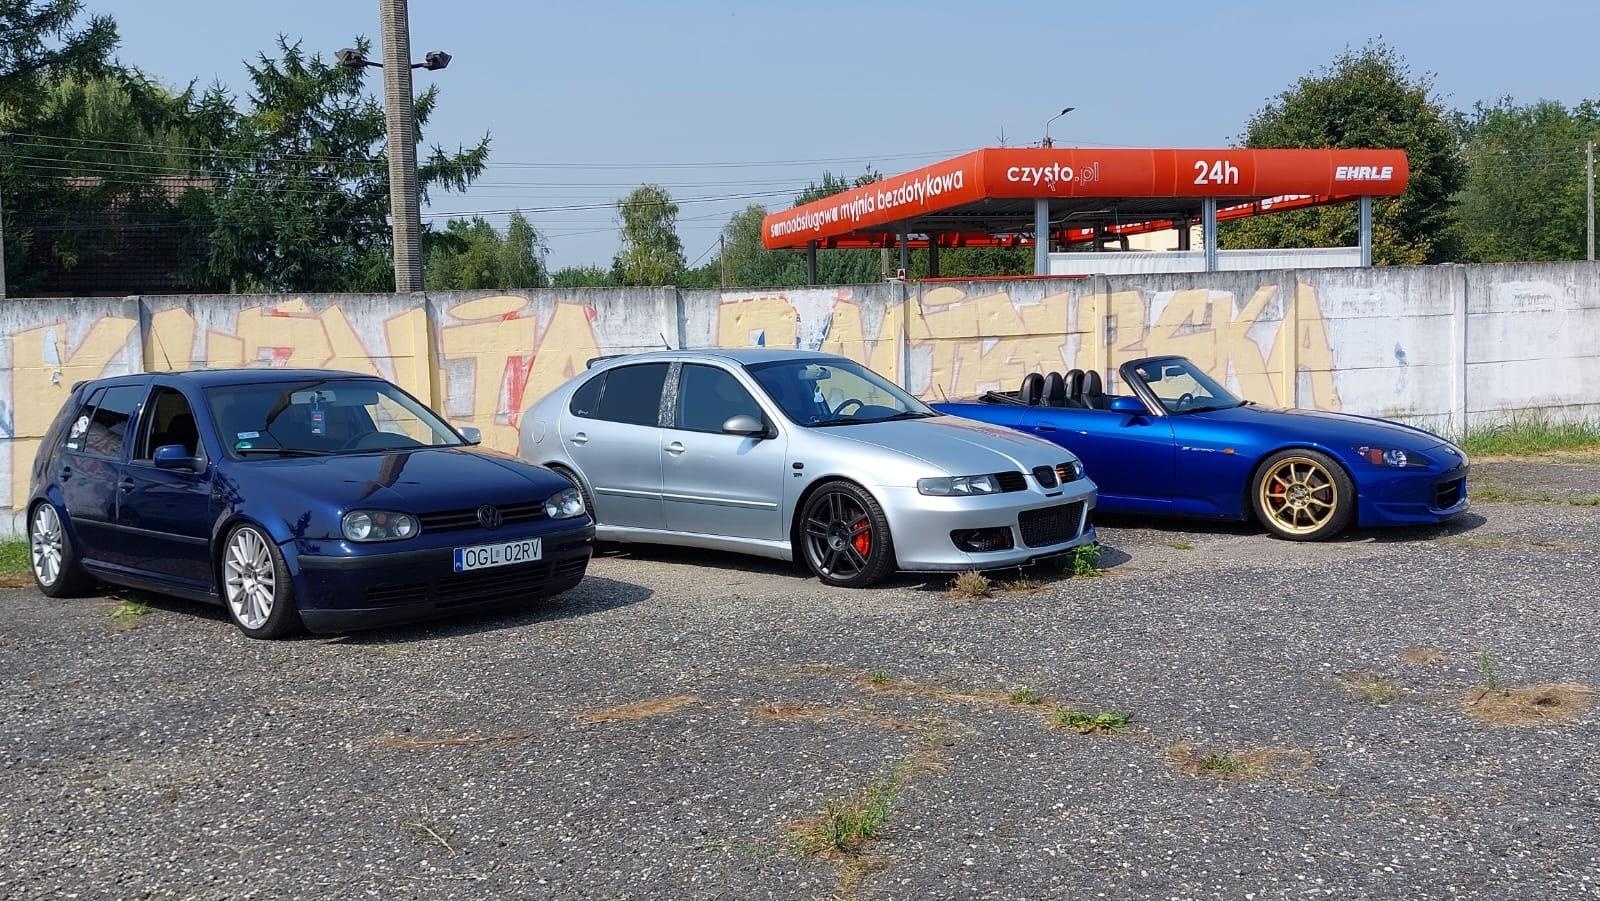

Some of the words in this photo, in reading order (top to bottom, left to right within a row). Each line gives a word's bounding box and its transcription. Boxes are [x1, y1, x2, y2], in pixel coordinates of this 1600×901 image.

[1007, 162, 1100, 187] czysto.pl
[1194, 160, 1239, 185] 24h
[1335, 166, 1393, 181] EHRLE
[840, 192, 875, 222] myjnia
[877, 170, 964, 210] bezdotykowa
[465, 547, 499, 567] OGL
[504, 541, 540, 562] 02RV
